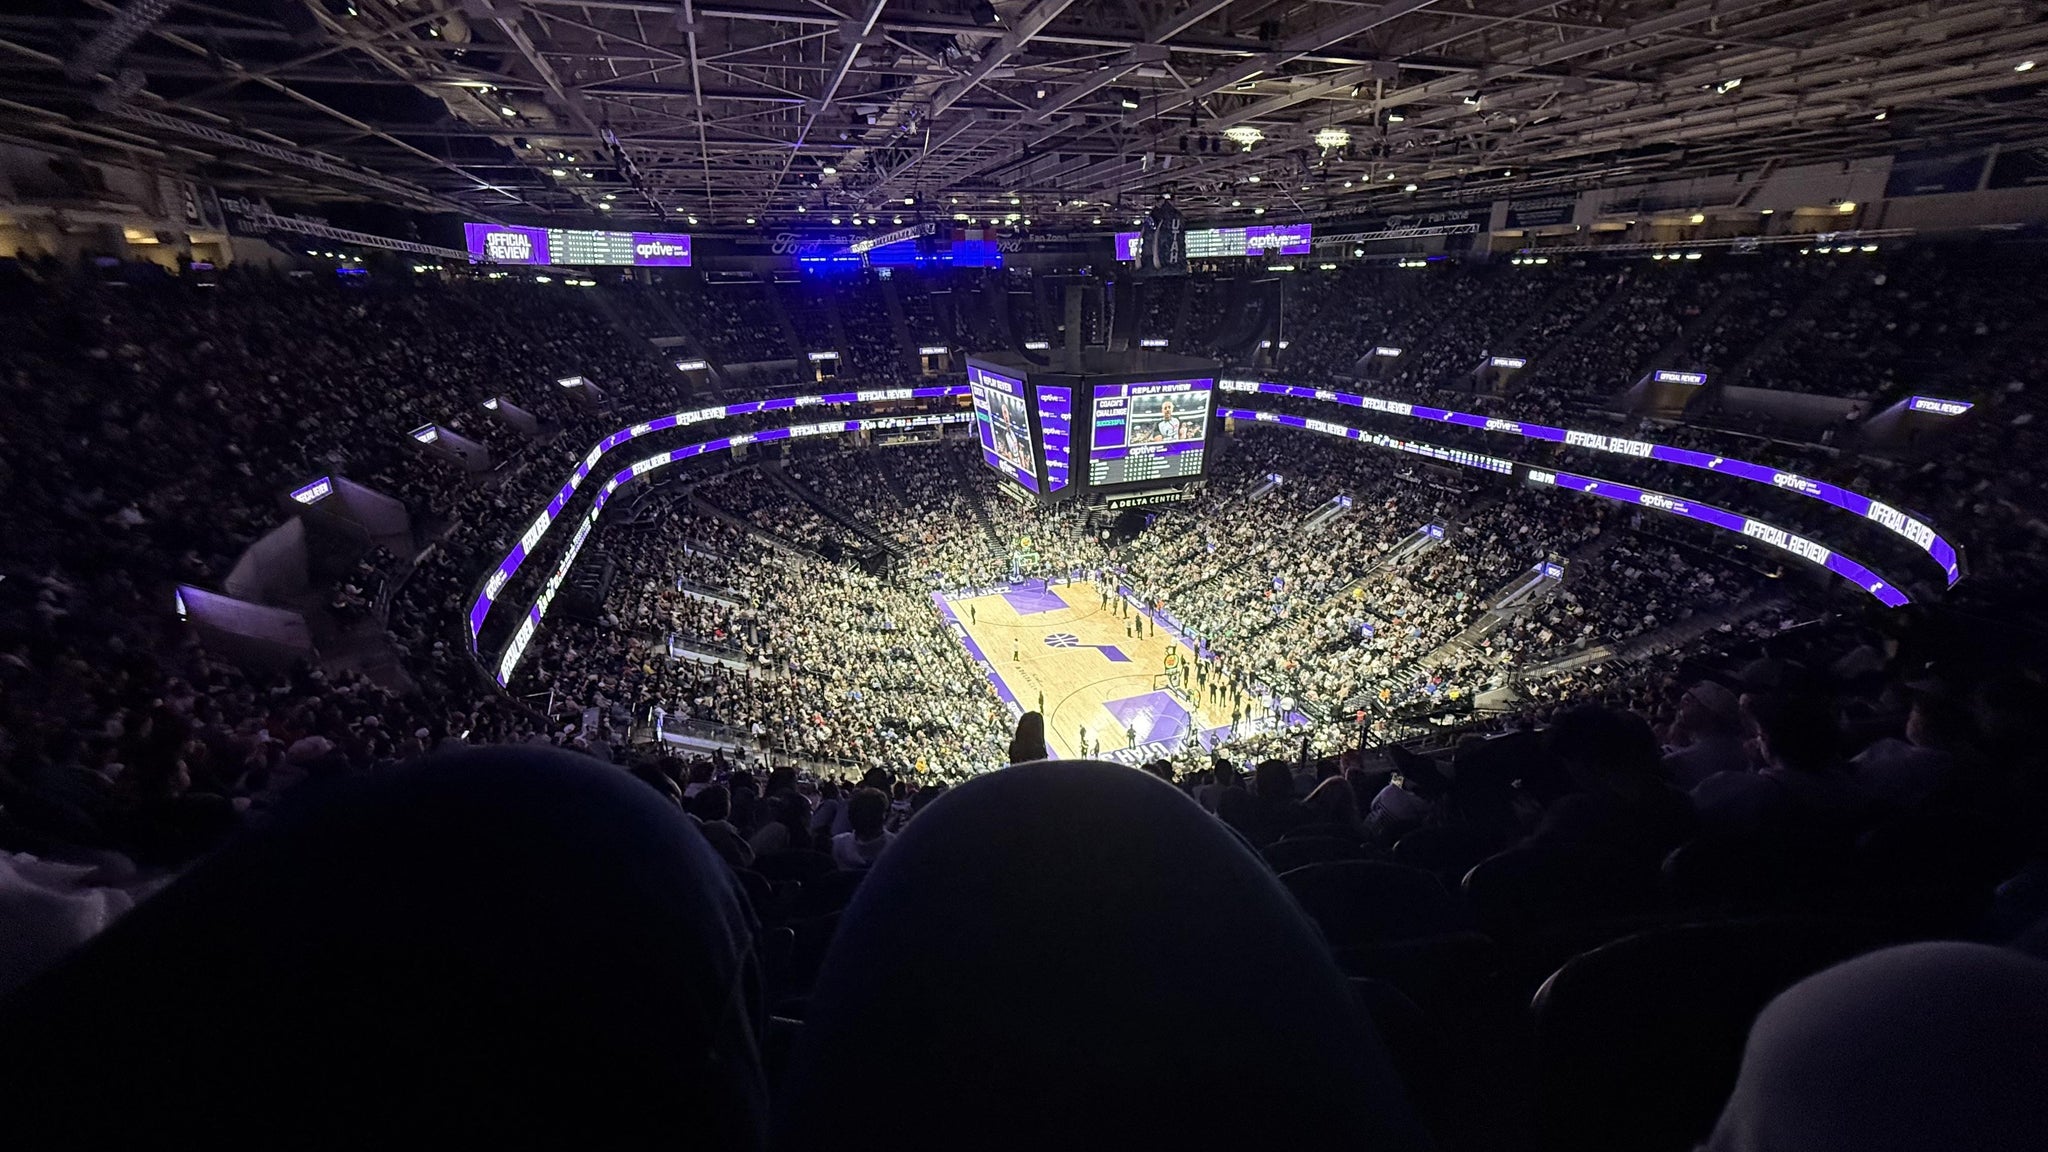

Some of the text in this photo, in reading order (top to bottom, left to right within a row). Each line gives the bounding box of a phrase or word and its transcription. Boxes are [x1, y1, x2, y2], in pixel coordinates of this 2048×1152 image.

[487, 233, 531, 247] OFFICIAL
[771, 232, 821, 255] Ford
[849, 234, 867, 245] Zon
[1169, 218, 1180, 264] UTAH
[1250, 233, 1289, 248] aptive
[490, 246, 529, 259] REVIEW
[637, 241, 672, 258] aptive
[858, 389, 912, 401] OFFICIAL REVIEW
[1132, 384, 1191, 395] REPLAY REVIEW
[1362, 397, 1387, 411] OFFICIAL
[790, 422, 845, 437] OFFICIAL REVIEW
[1305, 419, 1328, 433] OFFICIAL
[1566, 430, 1653, 457] OFFICIAL REVIEW
[1774, 473, 1806, 491] aptive
[1120, 494, 1181, 508] DELTA CENTER
[1640, 494, 1673, 509] aptive
[1867, 501, 1908, 535] OFFICIAL
[1743, 519, 1830, 566] OFFICIAL REVIEW
